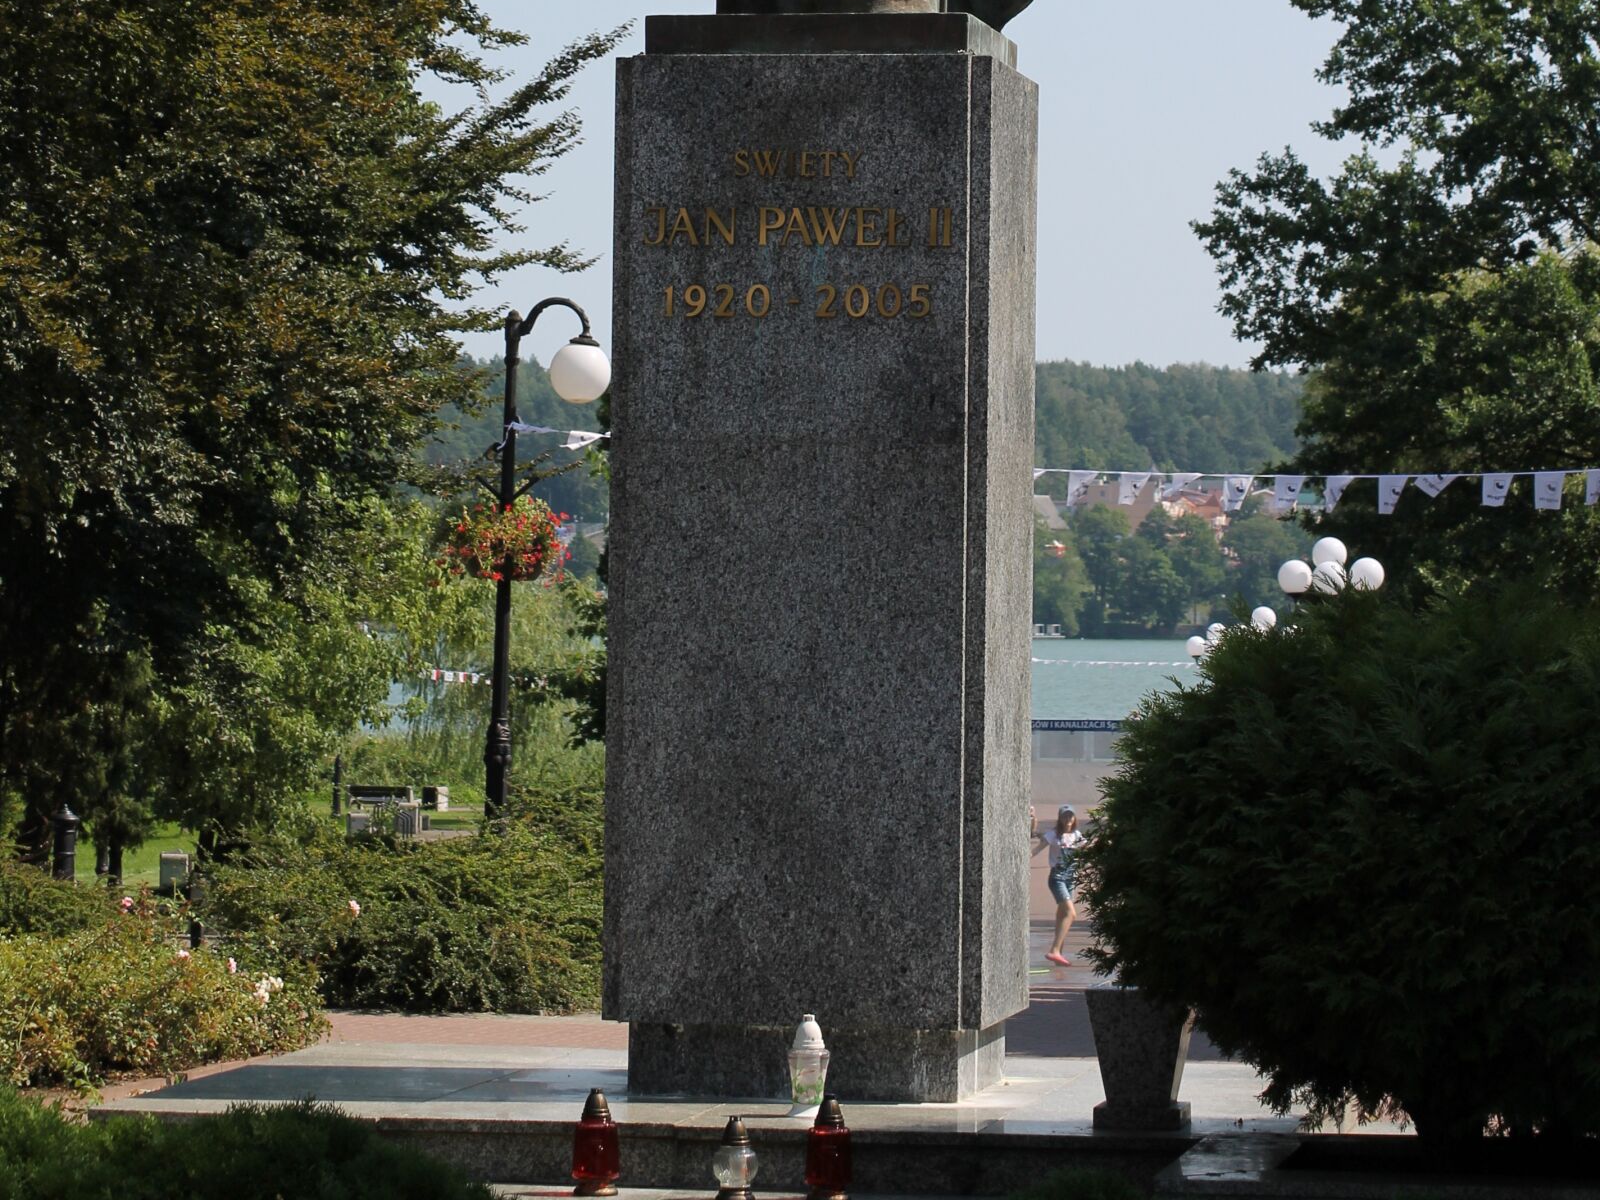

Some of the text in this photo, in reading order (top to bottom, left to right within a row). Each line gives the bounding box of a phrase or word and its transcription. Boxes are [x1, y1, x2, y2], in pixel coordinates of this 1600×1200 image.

[643, 206, 953, 247] JAN PAWEŁ II
[663, 283, 772, 318] 1920
[815, 283, 932, 318] 2005
